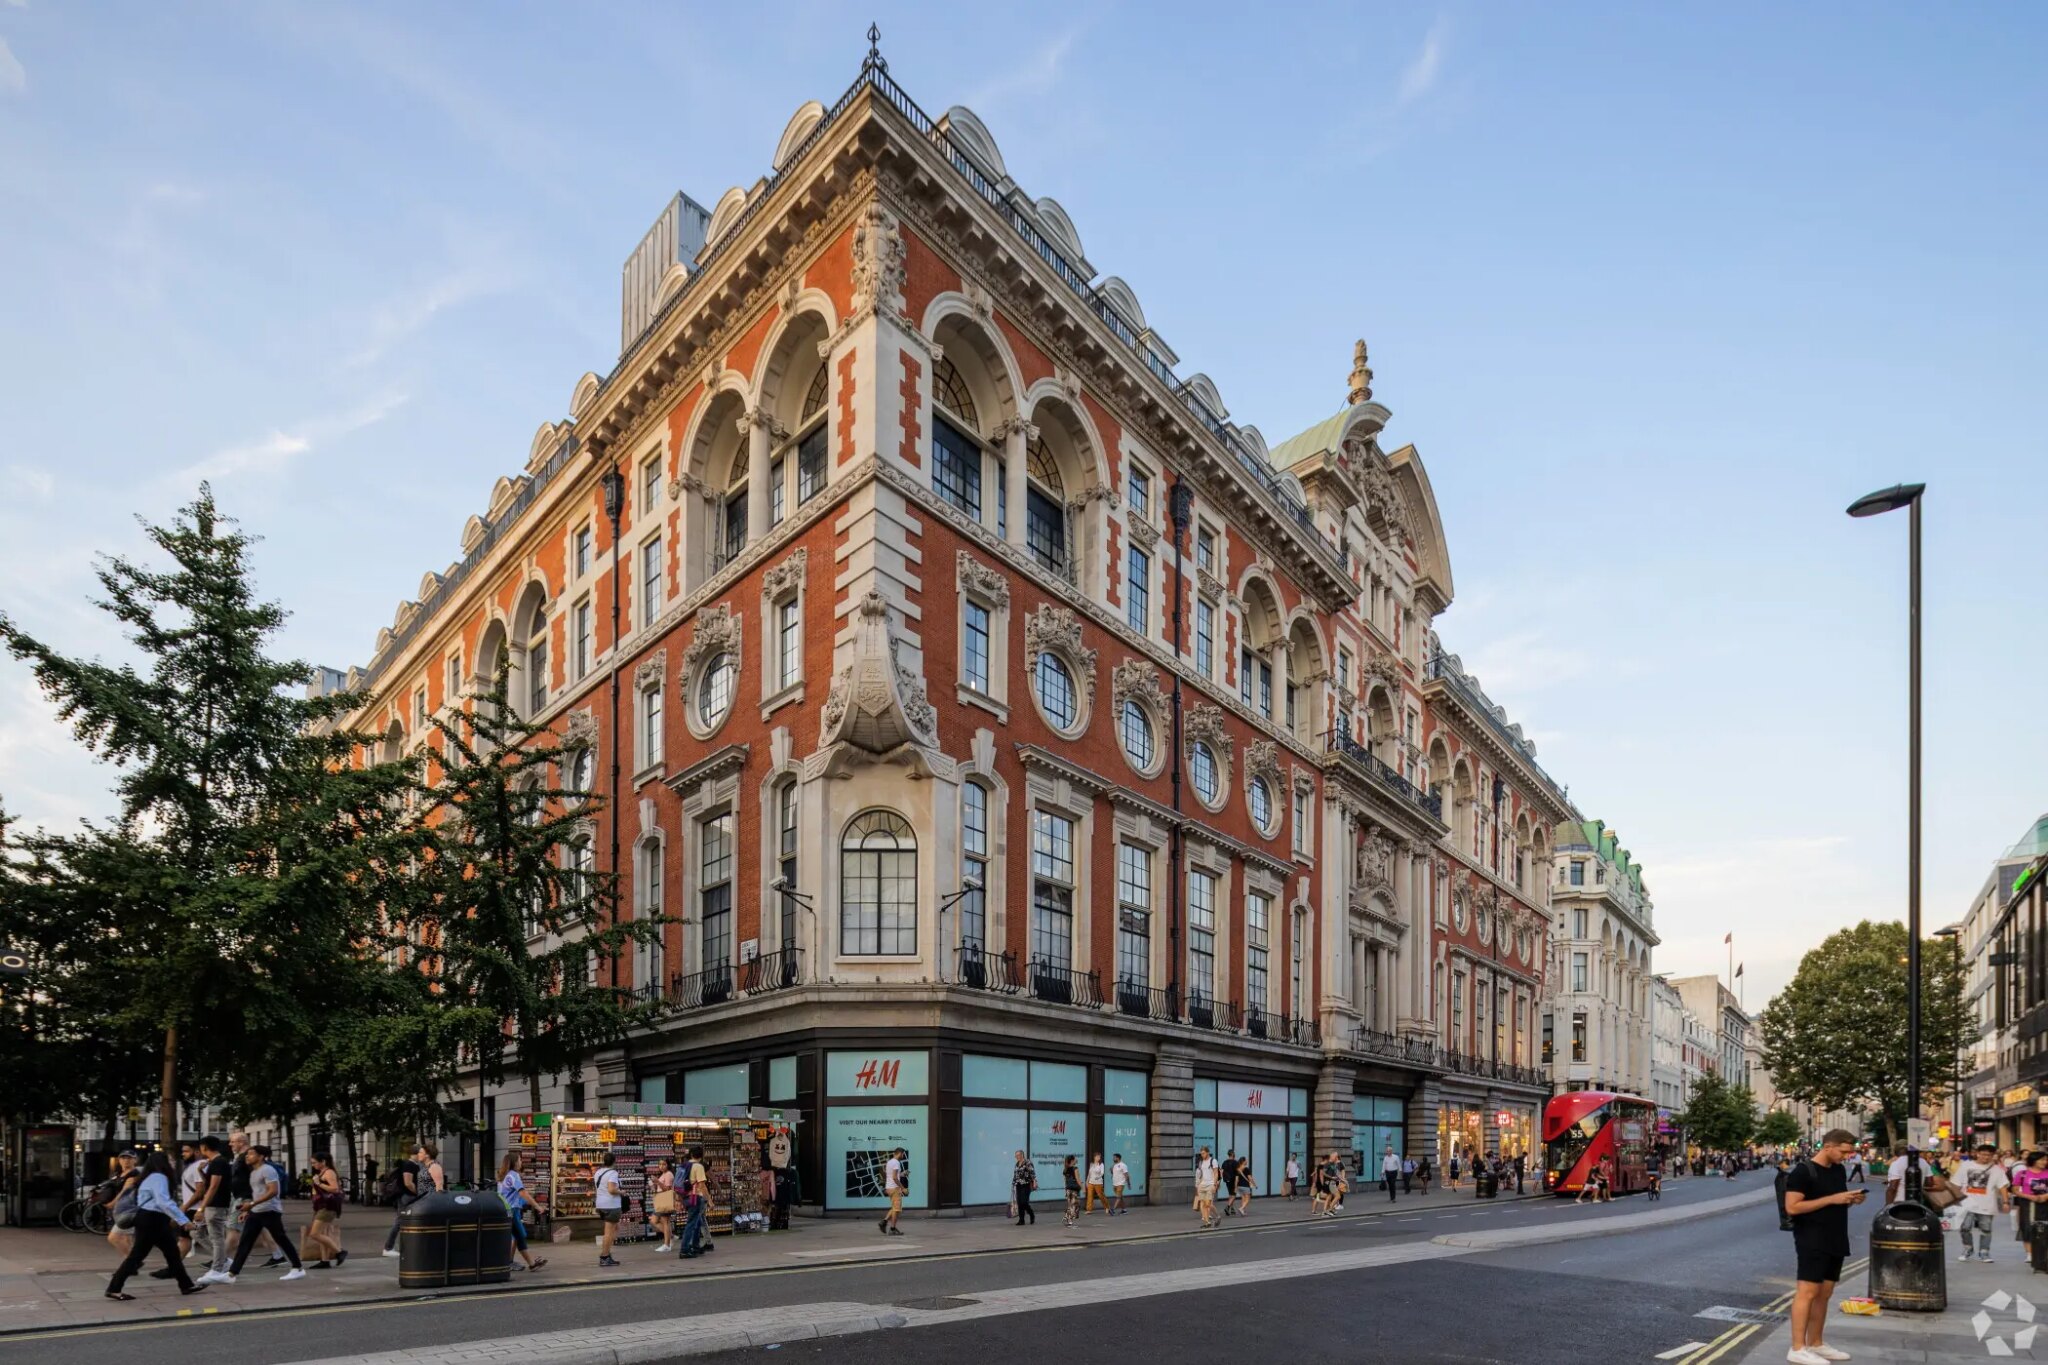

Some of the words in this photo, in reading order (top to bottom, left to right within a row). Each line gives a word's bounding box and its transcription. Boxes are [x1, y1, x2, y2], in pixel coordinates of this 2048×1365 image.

[0, 955, 24, 968] O
[856, 1059, 901, 1089] H&M
[1571, 1129, 1584, 1139] 55
[523, 1136, 537, 1144] £1
